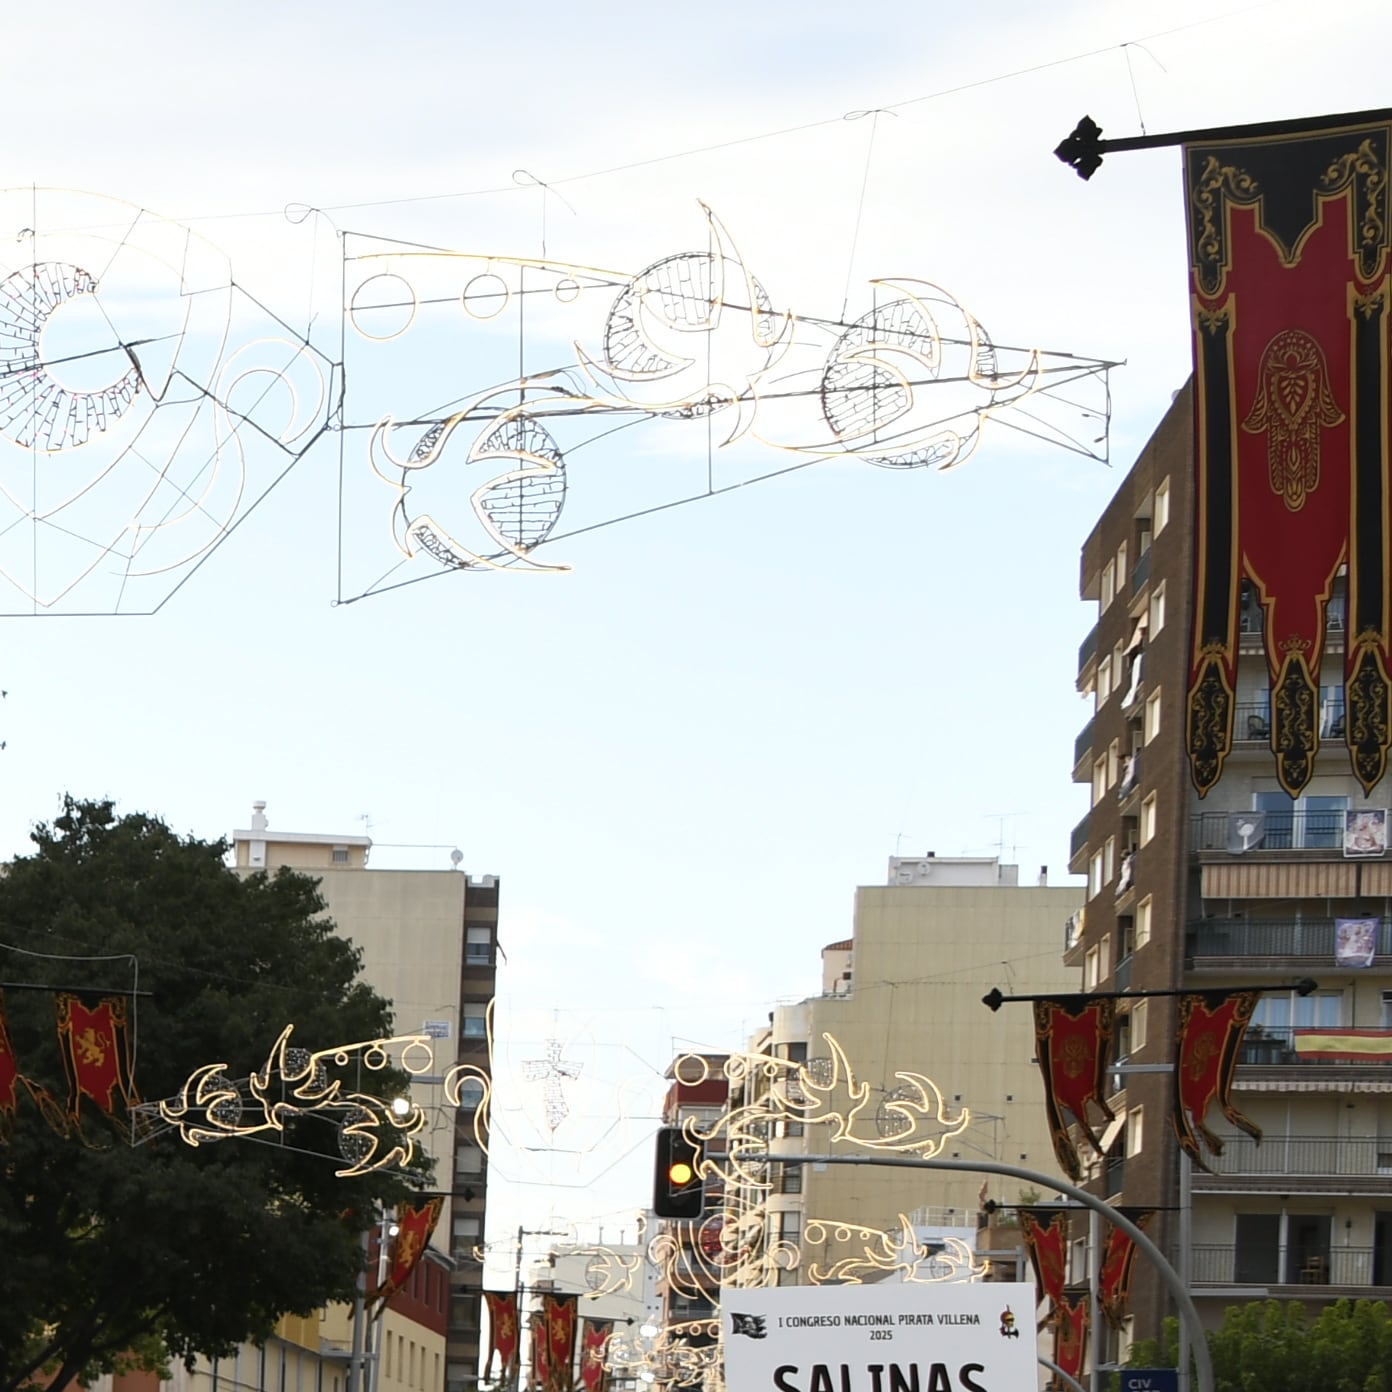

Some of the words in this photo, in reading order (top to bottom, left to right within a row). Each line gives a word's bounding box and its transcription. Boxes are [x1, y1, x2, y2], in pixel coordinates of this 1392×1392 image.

[778, 1316, 784, 1328] I
[785, 1315, 841, 1328] CONGRESO
[844, 1314, 896, 1327] NACIONAL
[898, 1314, 934, 1326] PIRATA
[937, 1313, 981, 1326] VILLENA
[869, 1330, 894, 1341] 2025
[1127, 1379, 1152, 1390] CIV
